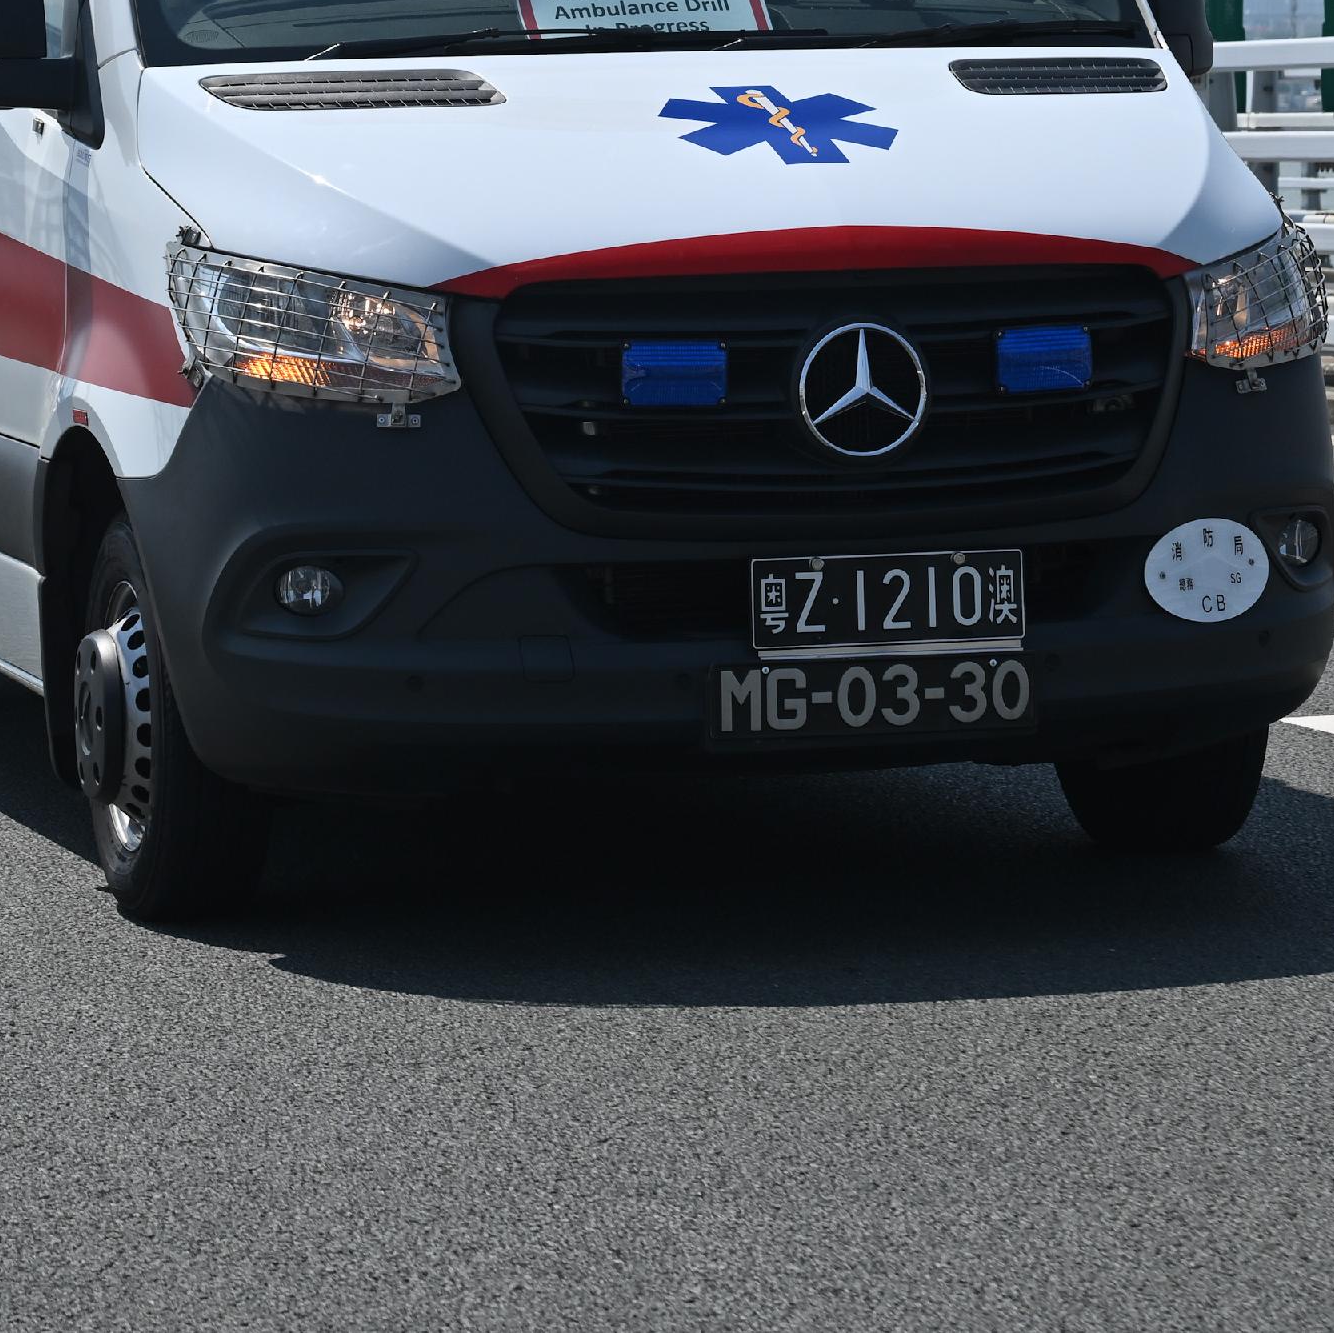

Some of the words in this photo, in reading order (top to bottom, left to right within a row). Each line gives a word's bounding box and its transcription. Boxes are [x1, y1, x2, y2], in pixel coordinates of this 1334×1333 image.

[555, 0, 679, 20] Ambulance
[1230, 573, 1242, 584] SG
[720, 659, 1030, 732] MG-03-30
